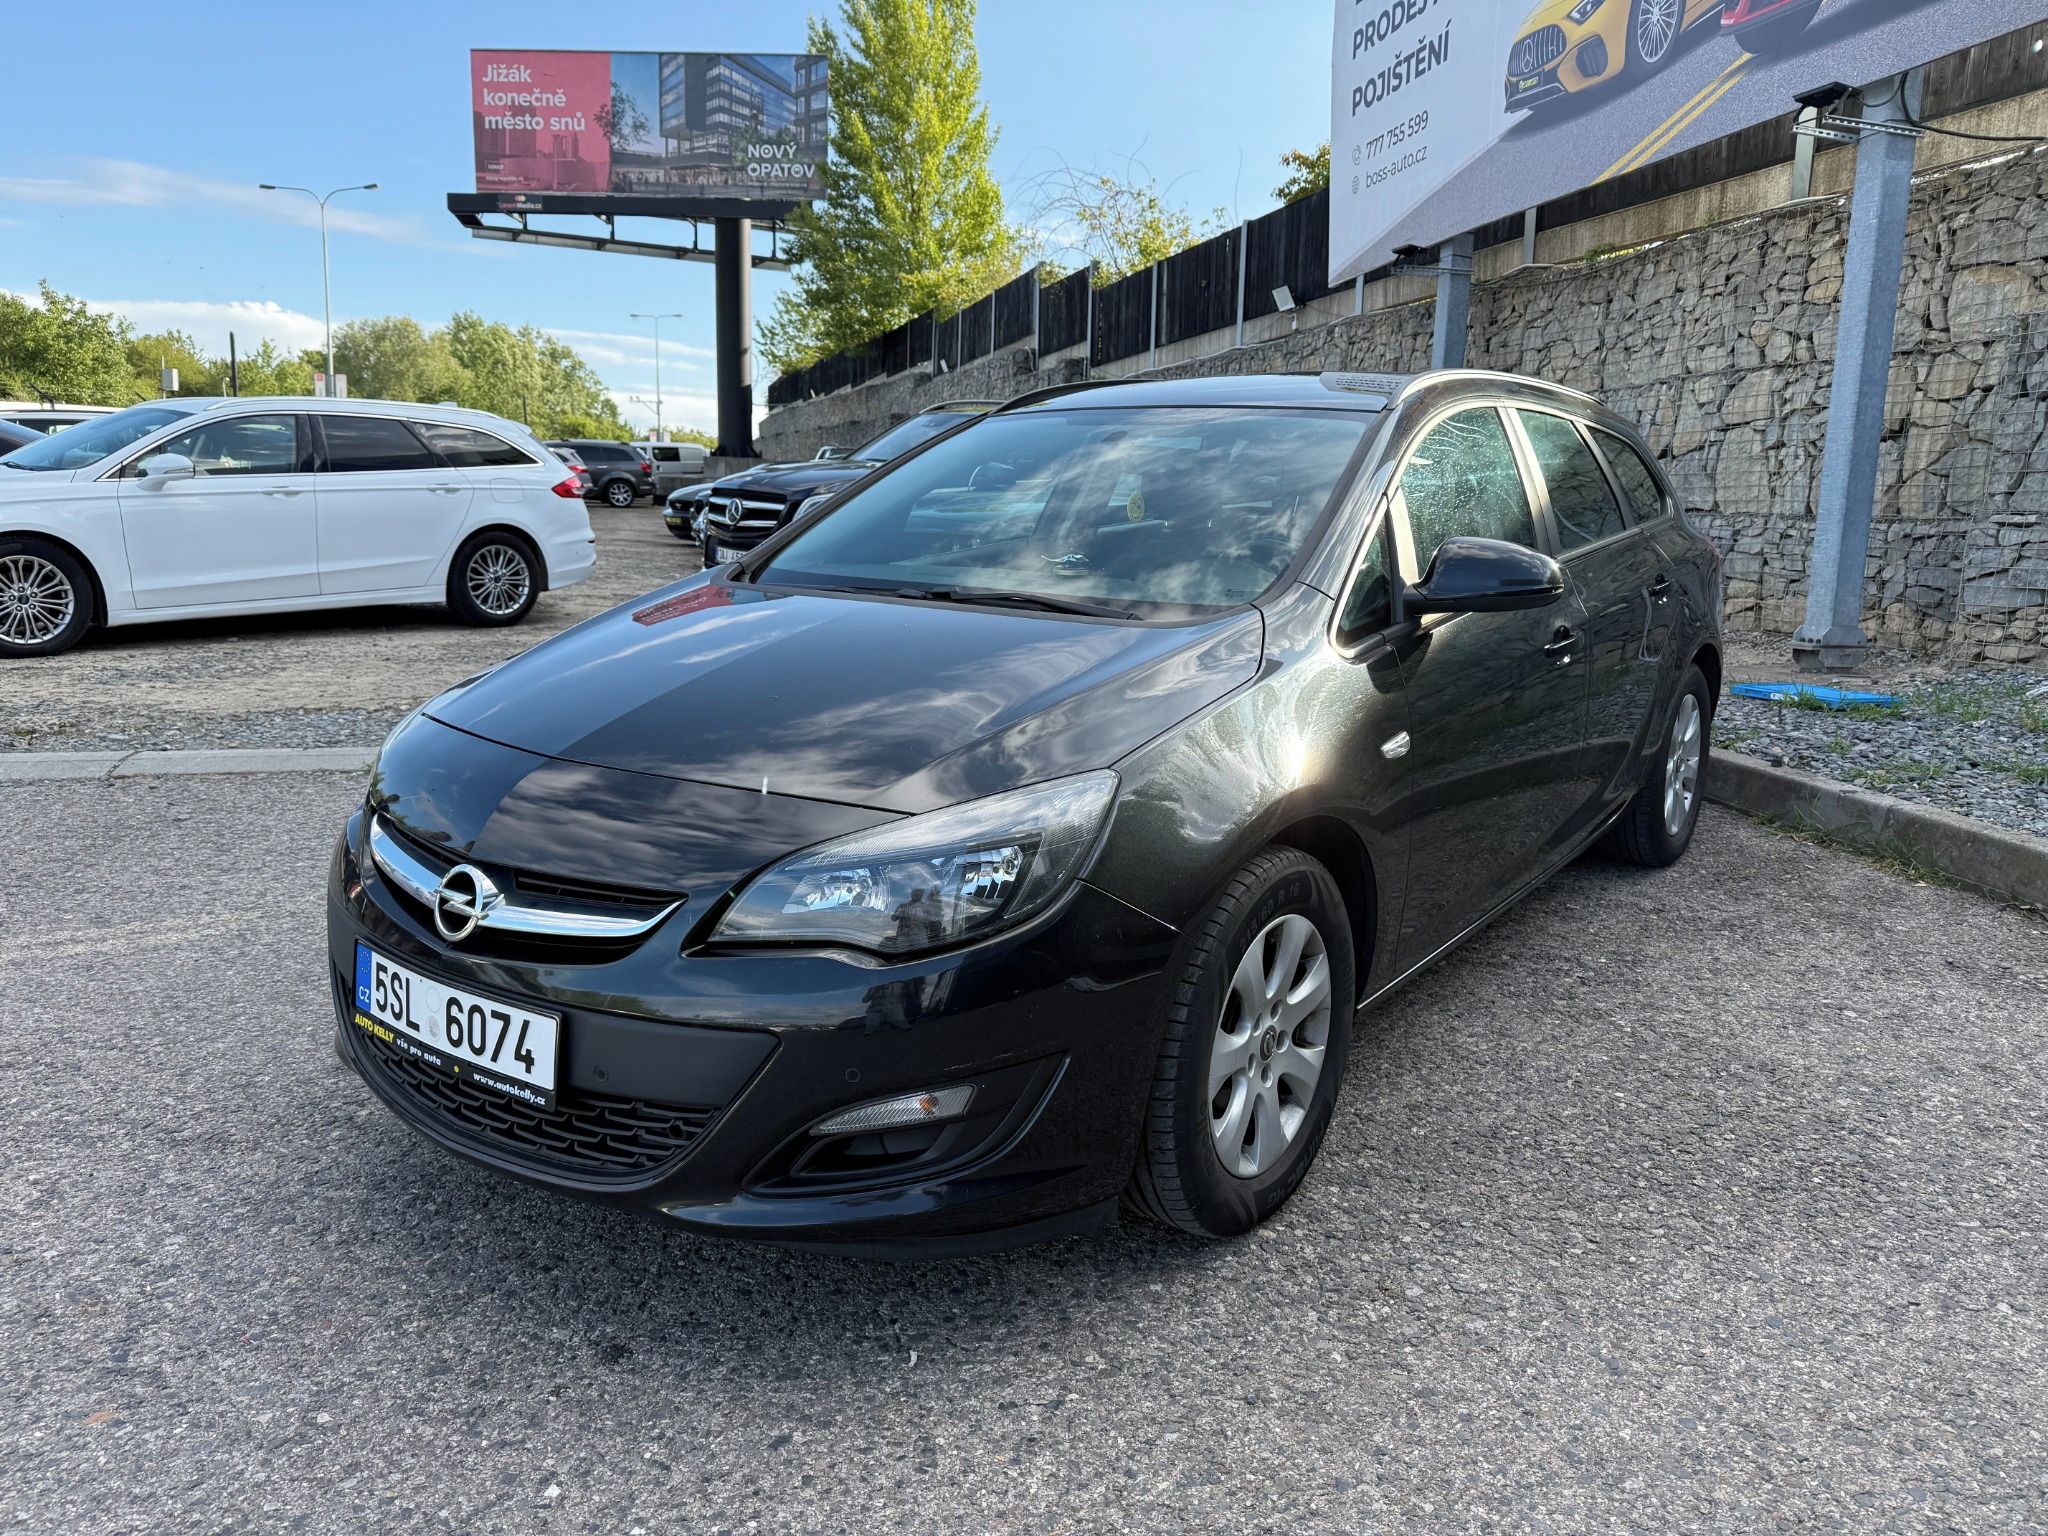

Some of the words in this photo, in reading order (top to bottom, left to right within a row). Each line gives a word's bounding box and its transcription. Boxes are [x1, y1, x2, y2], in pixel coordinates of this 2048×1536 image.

[482, 63, 532, 82] Jižák
[1352, 18, 1452, 117] POJIŠTĚNÍ
[483, 88, 567, 107] konečně
[484, 111, 545, 130] město
[550, 111, 586, 131] snů
[1365, 134, 1385, 160] 777
[1386, 122, 1406, 149] 755
[1407, 110, 1428, 138] 599
[747, 141, 798, 159] NOVÝ
[747, 162, 815, 178] OPATOV
[1365, 145, 1428, 189] boss-auto.cz
[358, 985, 370, 1004] CZ
[375, 961, 420, 1033] 5SL
[445, 996, 535, 1074] 6074
[354, 1013, 373, 1032] AUTO
[373, 1023, 395, 1043] KELLY
[409, 1045, 422, 1057] pro
[423, 1052, 442, 1066] auta
[472, 1072, 546, 1106] www.autokelly.cz
